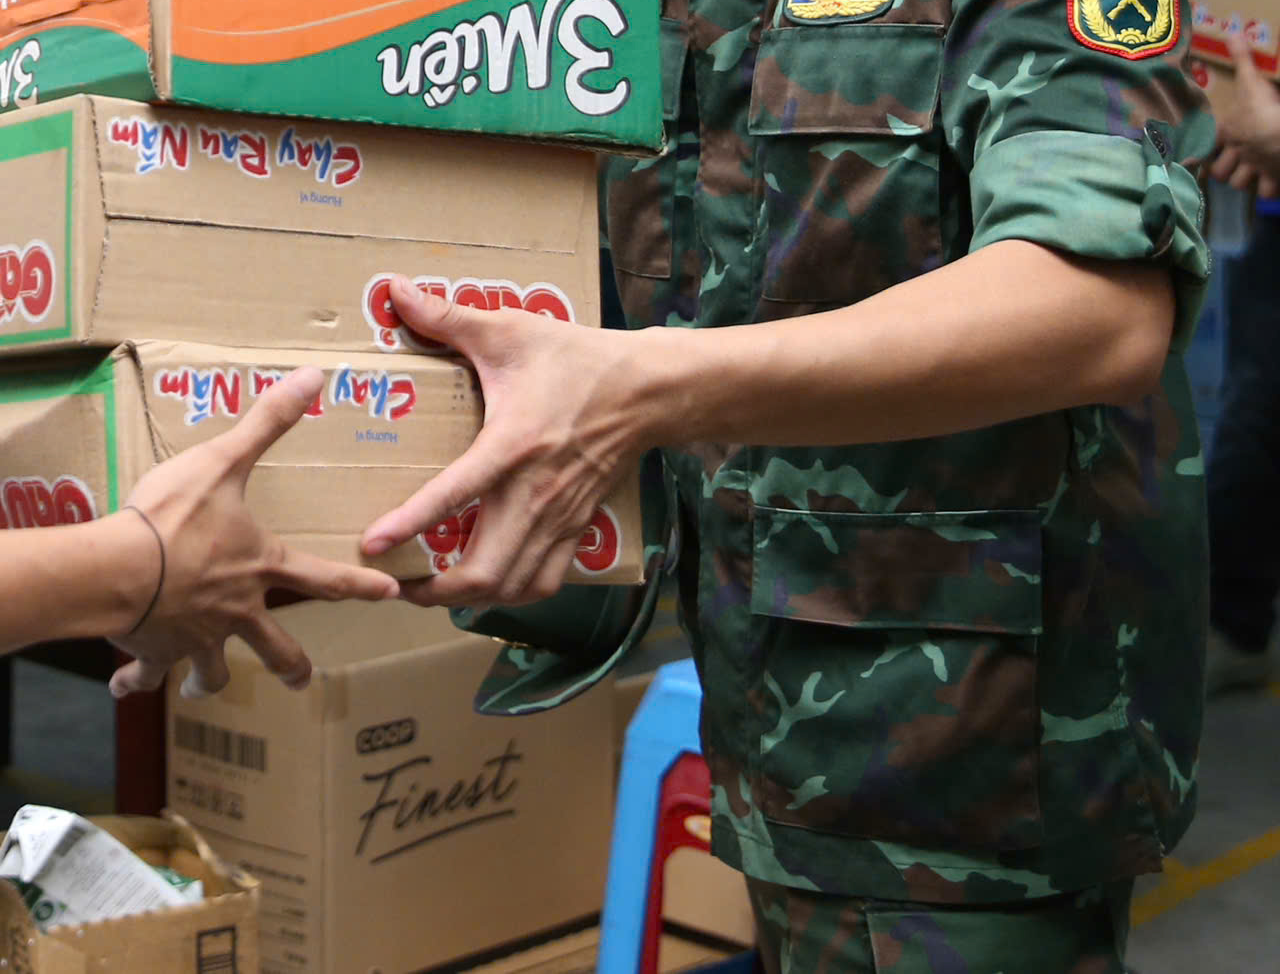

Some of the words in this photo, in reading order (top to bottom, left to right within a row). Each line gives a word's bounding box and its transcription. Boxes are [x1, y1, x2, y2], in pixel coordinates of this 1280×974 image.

[111, 122, 188, 172] Nấm
[201, 128, 268, 176] Rau
[279, 127, 361, 184] Chay
[158, 369, 239, 423] Nấm
[334, 366, 415, 419] Chay
[355, 739, 524, 856] Finest
